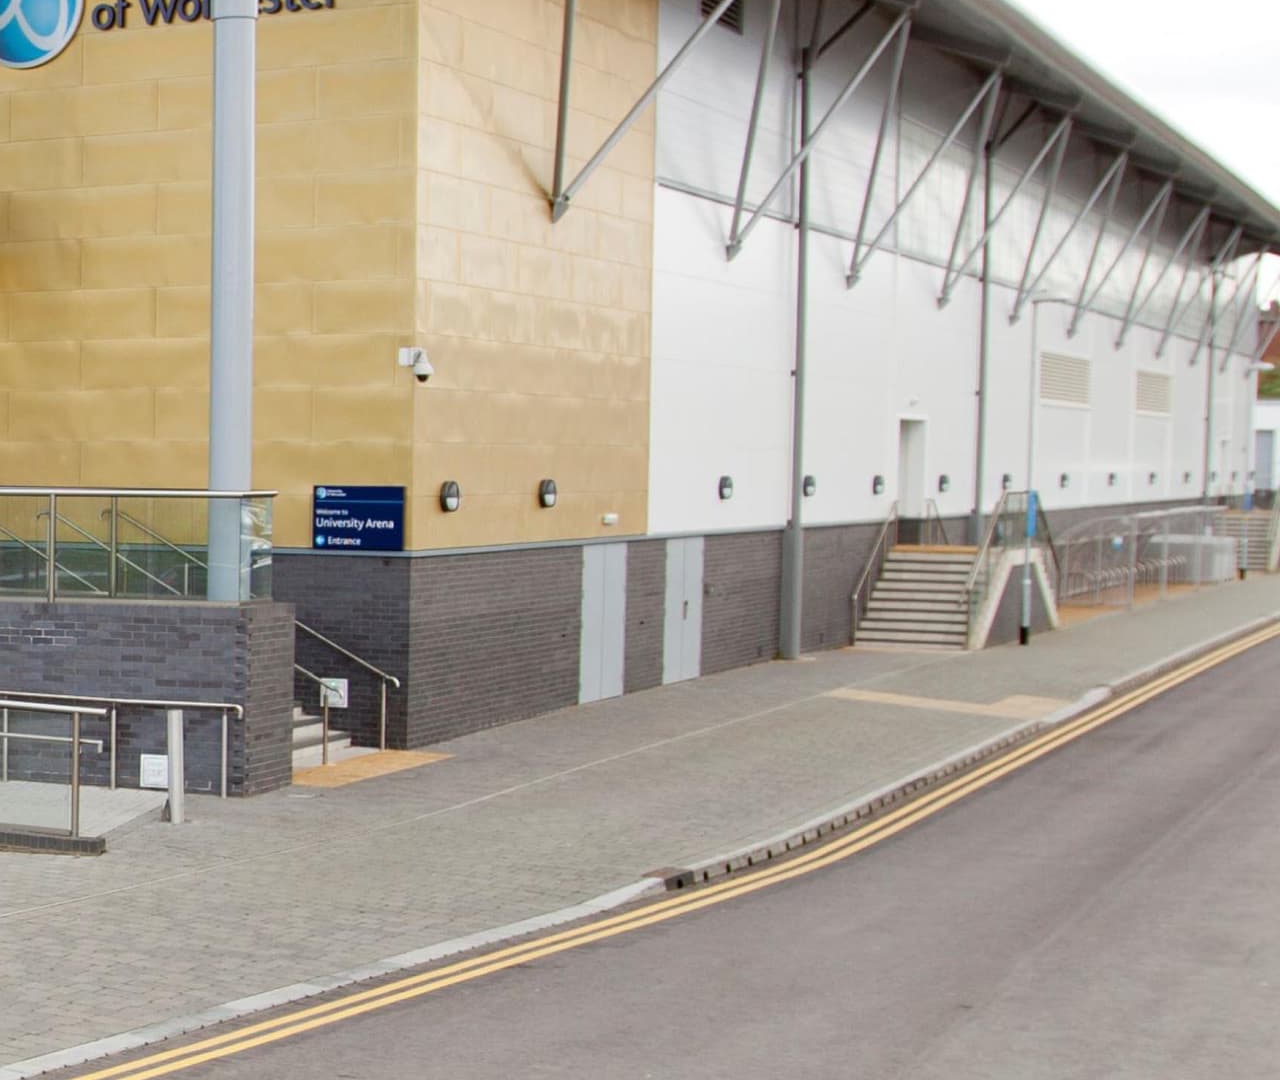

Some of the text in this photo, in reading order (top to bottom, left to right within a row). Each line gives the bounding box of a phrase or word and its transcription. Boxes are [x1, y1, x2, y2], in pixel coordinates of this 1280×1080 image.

[316, 517, 394, 531] University Arena
[328, 536, 361, 546] Entrance
